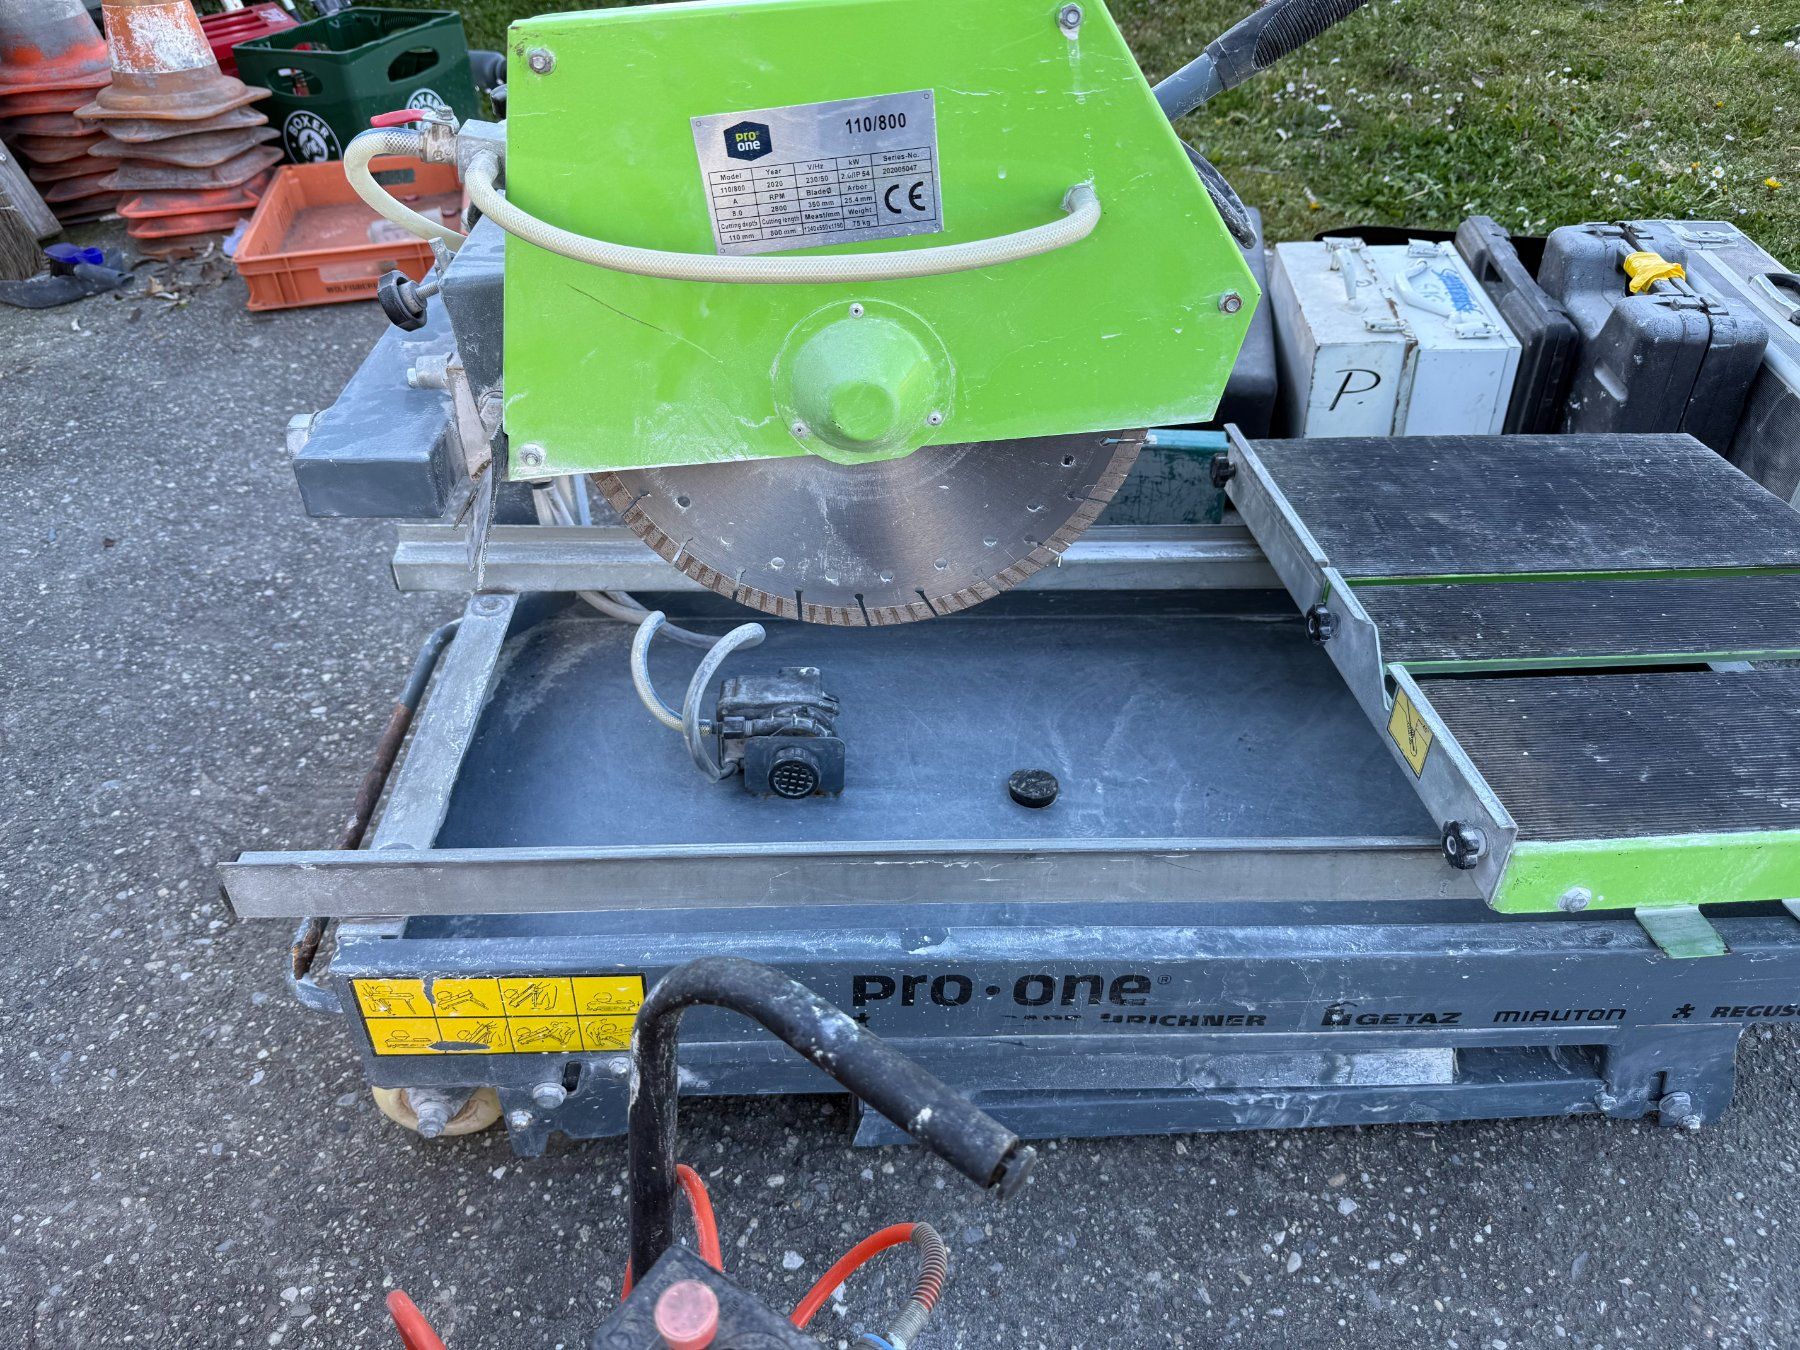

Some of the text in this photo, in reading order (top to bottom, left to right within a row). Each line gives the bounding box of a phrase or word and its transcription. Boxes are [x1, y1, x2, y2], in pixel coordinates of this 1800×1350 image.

[411, 94, 440, 109] OXER
[288, 115, 330, 140] BOXER
[846, 112, 907, 135] 110/800
[735, 131, 757, 142] pro
[737, 140, 761, 152] one
[848, 158, 860, 166] kW
[883, 153, 920, 162] Series-No.
[765, 168, 782, 176] Year
[861, 170, 871, 178] 54
[720, 173, 742, 181] Model
[806, 175, 829, 184] 230/50
[720, 185, 746, 194] 110/800
[766, 181, 784, 189] 2020
[847, 184, 868, 192] Arbor
[769, 193, 786, 201] RPM
[844, 196, 858, 204] 25.4
[848, 206, 872, 216] Weight
[762, 215, 800, 226] Cutting length
[862, 220, 871, 228] kg
[720, 222, 742, 230] Cutting
[729, 234, 741, 242] 110
[1493, 1008, 1627, 1023] MIAUTON
[1710, 1004, 1800, 1018] REGUS
[1356, 1012, 1462, 1025] GETAZ
